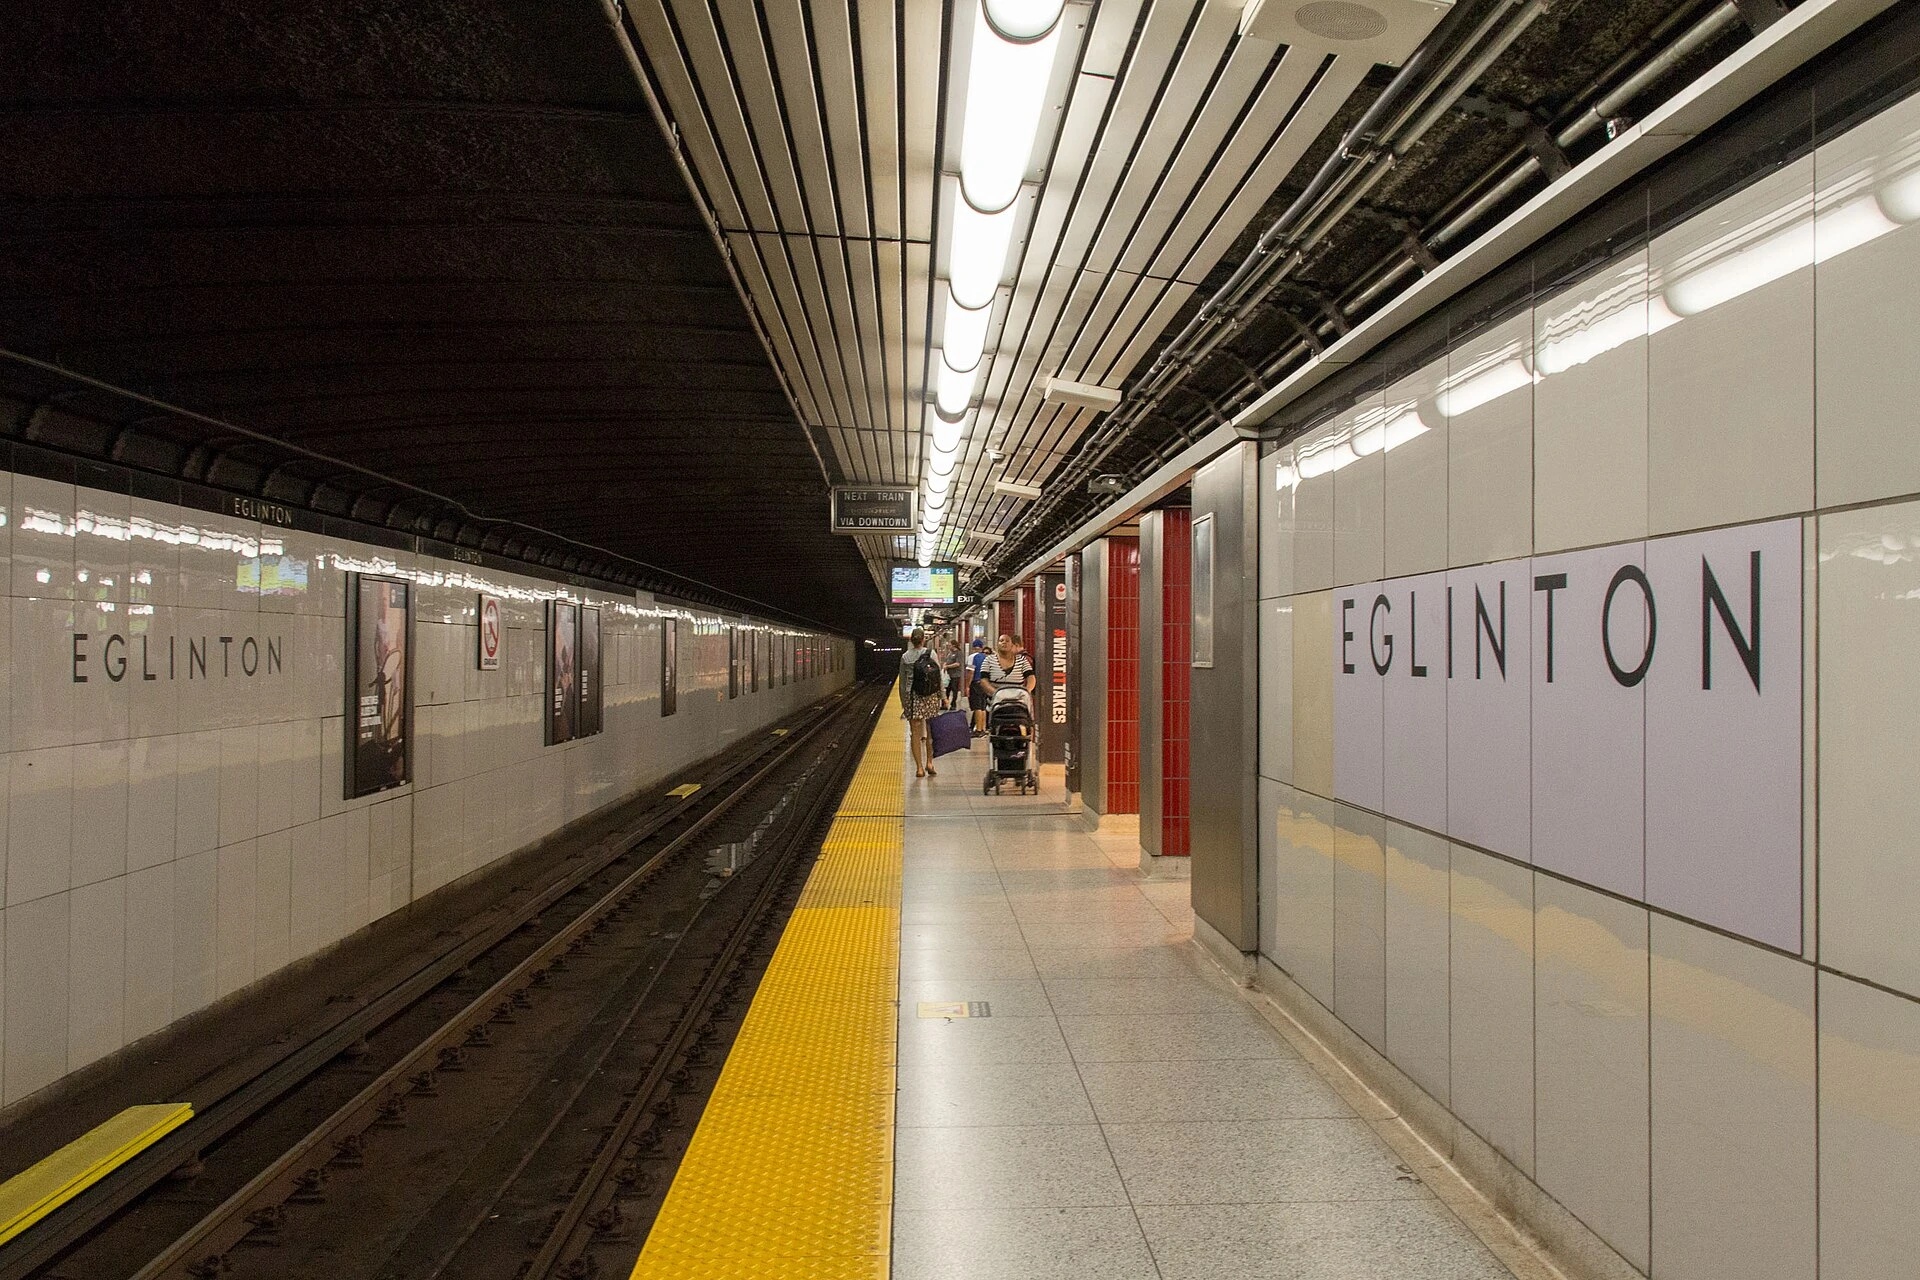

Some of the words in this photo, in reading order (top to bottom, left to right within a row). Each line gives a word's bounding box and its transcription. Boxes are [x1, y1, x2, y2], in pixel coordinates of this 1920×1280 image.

[844, 492, 867, 501] NEXT
[877, 492, 904, 501] TRAIN
[234, 497, 292, 524] EGLINTON
[840, 518, 854, 526] VIA
[858, 517, 908, 526] DOWNTOWN
[957, 595, 975, 603] EXIT
[1341, 550, 1762, 696] EGLINTON
[73, 632, 283, 682] EGLINTON
